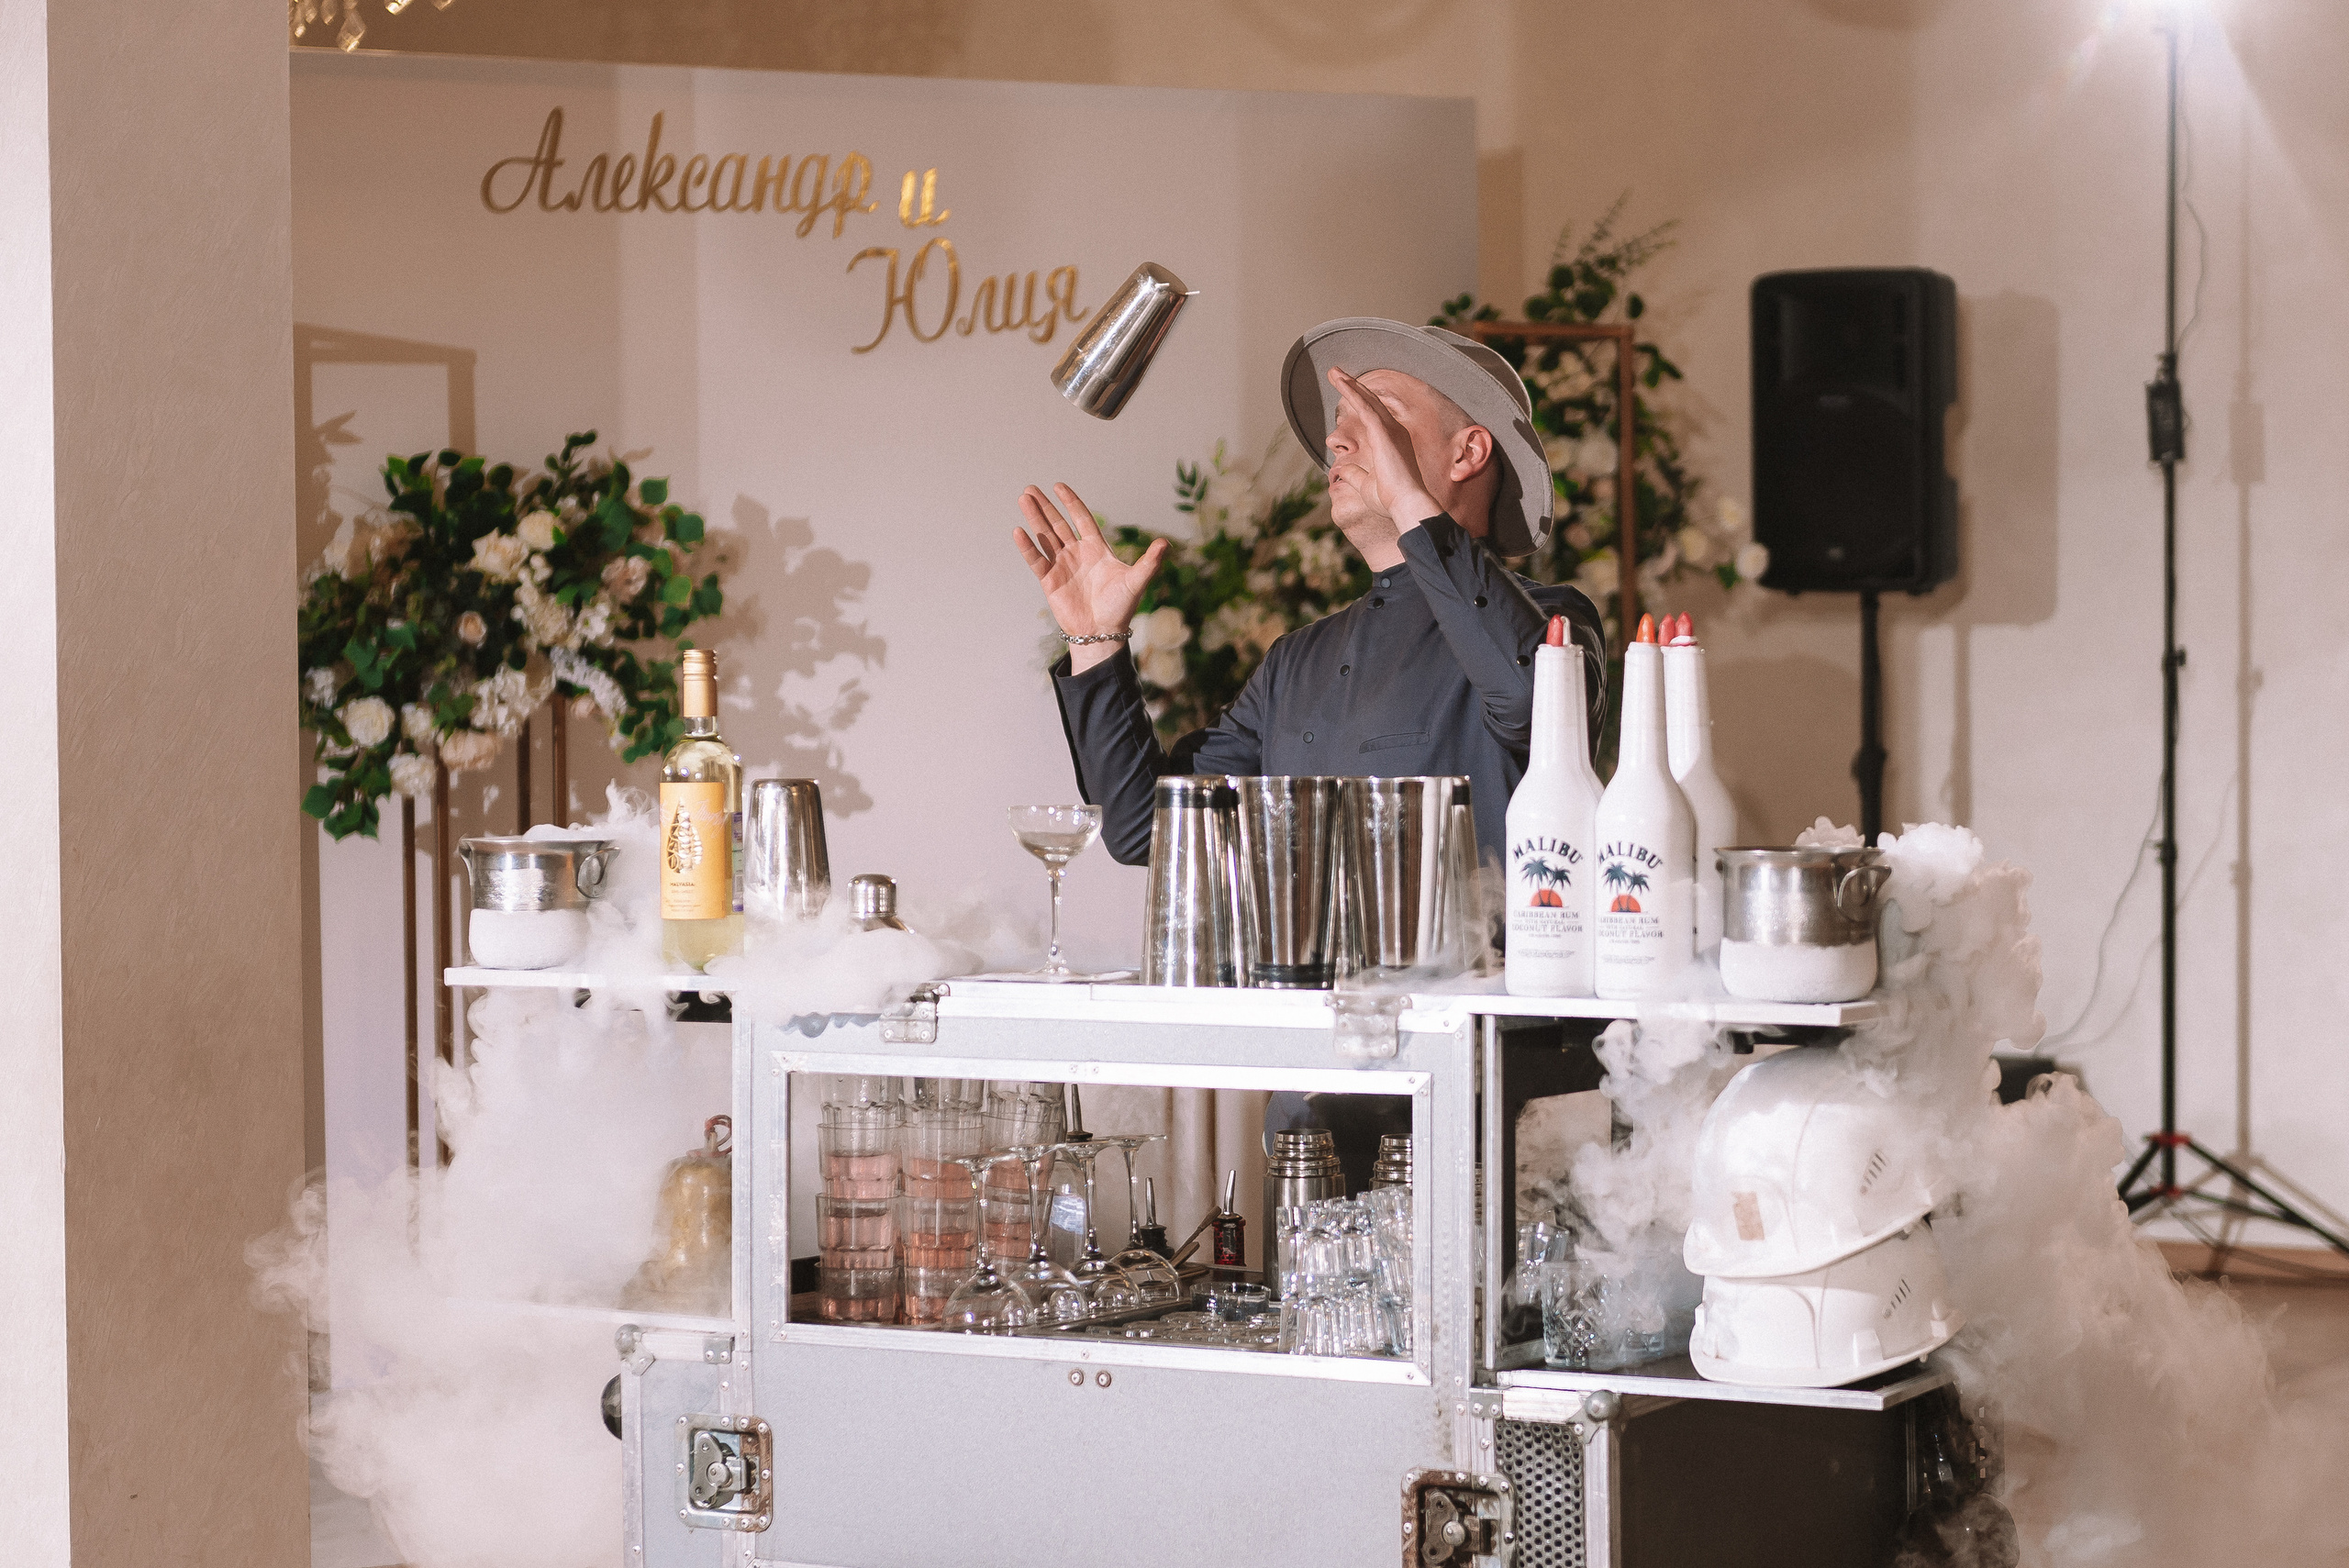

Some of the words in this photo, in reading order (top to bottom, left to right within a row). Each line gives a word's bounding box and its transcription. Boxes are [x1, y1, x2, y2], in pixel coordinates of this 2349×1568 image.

[480, 106, 878, 239] Александр
[897, 167, 951, 227] и
[845, 237, 1089, 354] Юлия
[1511, 836, 1582, 864] MALIBU
[1598, 841, 1662, 870] MALIBU
